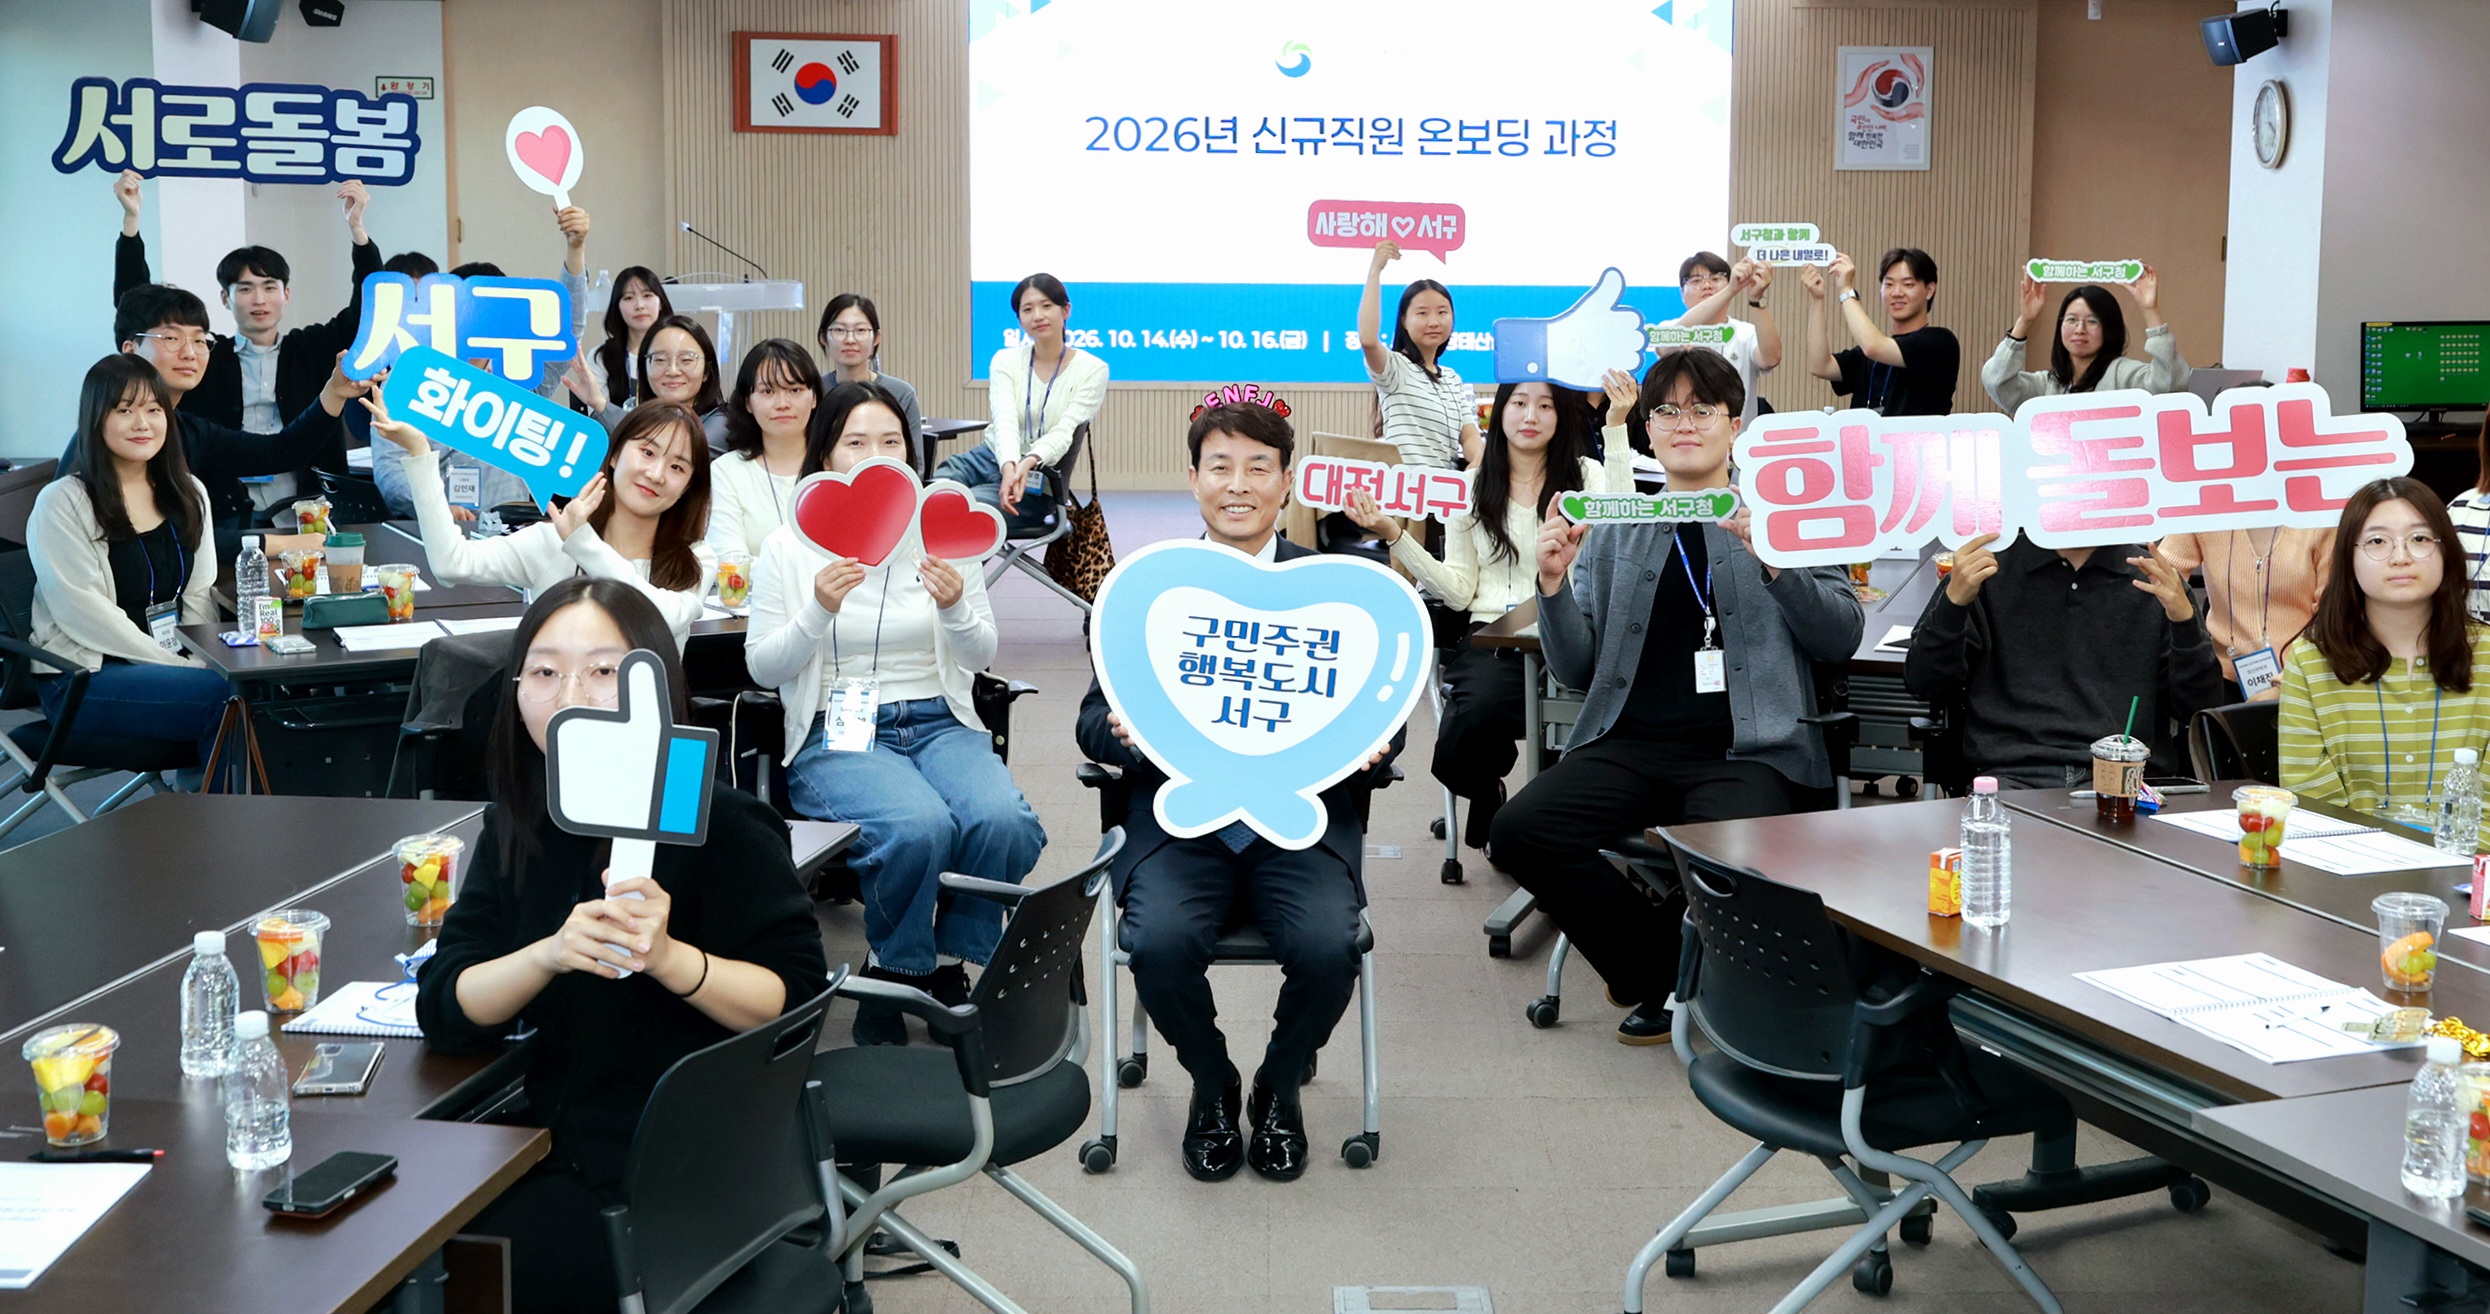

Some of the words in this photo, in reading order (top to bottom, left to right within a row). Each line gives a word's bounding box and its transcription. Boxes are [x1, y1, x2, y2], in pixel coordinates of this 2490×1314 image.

[61, 85, 412, 178] 서로돌봄
[1085, 115, 1239, 154] 2026년
[1252, 116, 1404, 156] 신규직원
[1417, 117, 1530, 157] 온보딩
[1543, 118, 1617, 158] 과정
[1314, 211, 1388, 238] 사랑해
[1416, 214, 1458, 240] 서구
[1740, 227, 1785, 241] 서구청과
[1787, 227, 1811, 241] 함께
[1757, 249, 1767, 261] 더
[1769, 249, 1790, 261] 나은
[1792, 249, 1828, 261] 내일로!
[2042, 264, 2089, 278] 함께하는
[2091, 264, 2127, 279] 서구청
[353, 282, 567, 382] 서구
[1108, 329, 1137, 348] 10.
[1141, 328, 1198, 349] 14.(수)
[1218, 330, 1247, 349] 10.
[1251, 329, 1308, 350] 16.(금)
[1649, 329, 1691, 343] 함께하는
[1693, 329, 1723, 342] 서구청
[1204, 383, 1275, 409] ENFJ
[407, 366, 588, 479] 화이팅!
[1747, 423, 2001, 553] 함께
[2025, 398, 2398, 534] 돌보는
[1583, 499, 1655, 518] 함께하는
[1659, 498, 1714, 517] 서구청
[259, 608, 278, 617] Real
[1182, 615, 1341, 662] 구민주권
[1178, 651, 1338, 698] 행복도시
[1211, 695, 1292, 733] 서구
